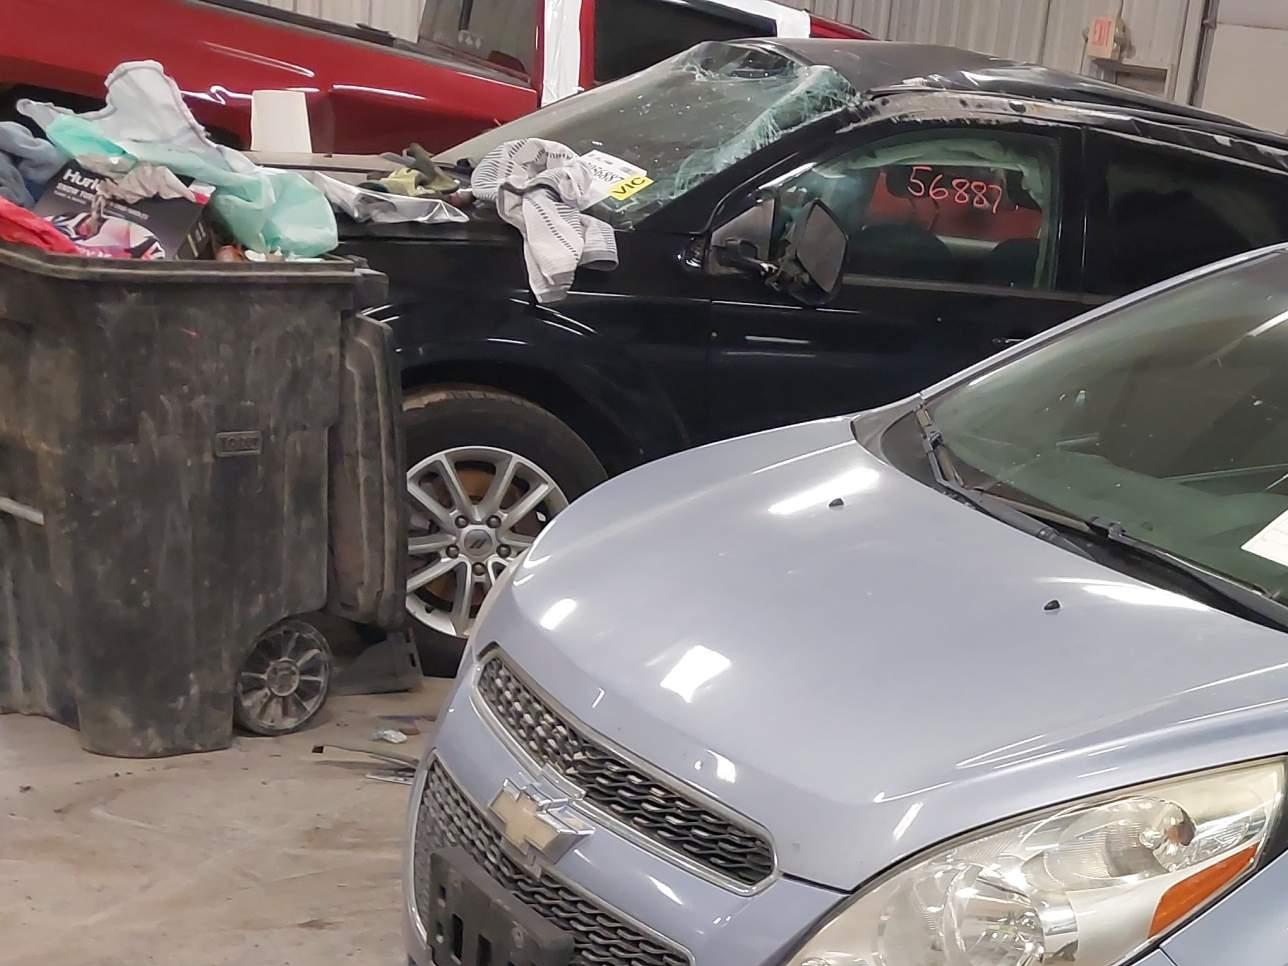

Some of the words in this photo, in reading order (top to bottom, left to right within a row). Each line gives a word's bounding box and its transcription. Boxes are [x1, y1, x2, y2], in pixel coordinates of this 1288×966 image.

[62, 168, 100, 190] Hurl
[611, 176, 647, 195] VIC
[907, 166, 1003, 214] 56887
